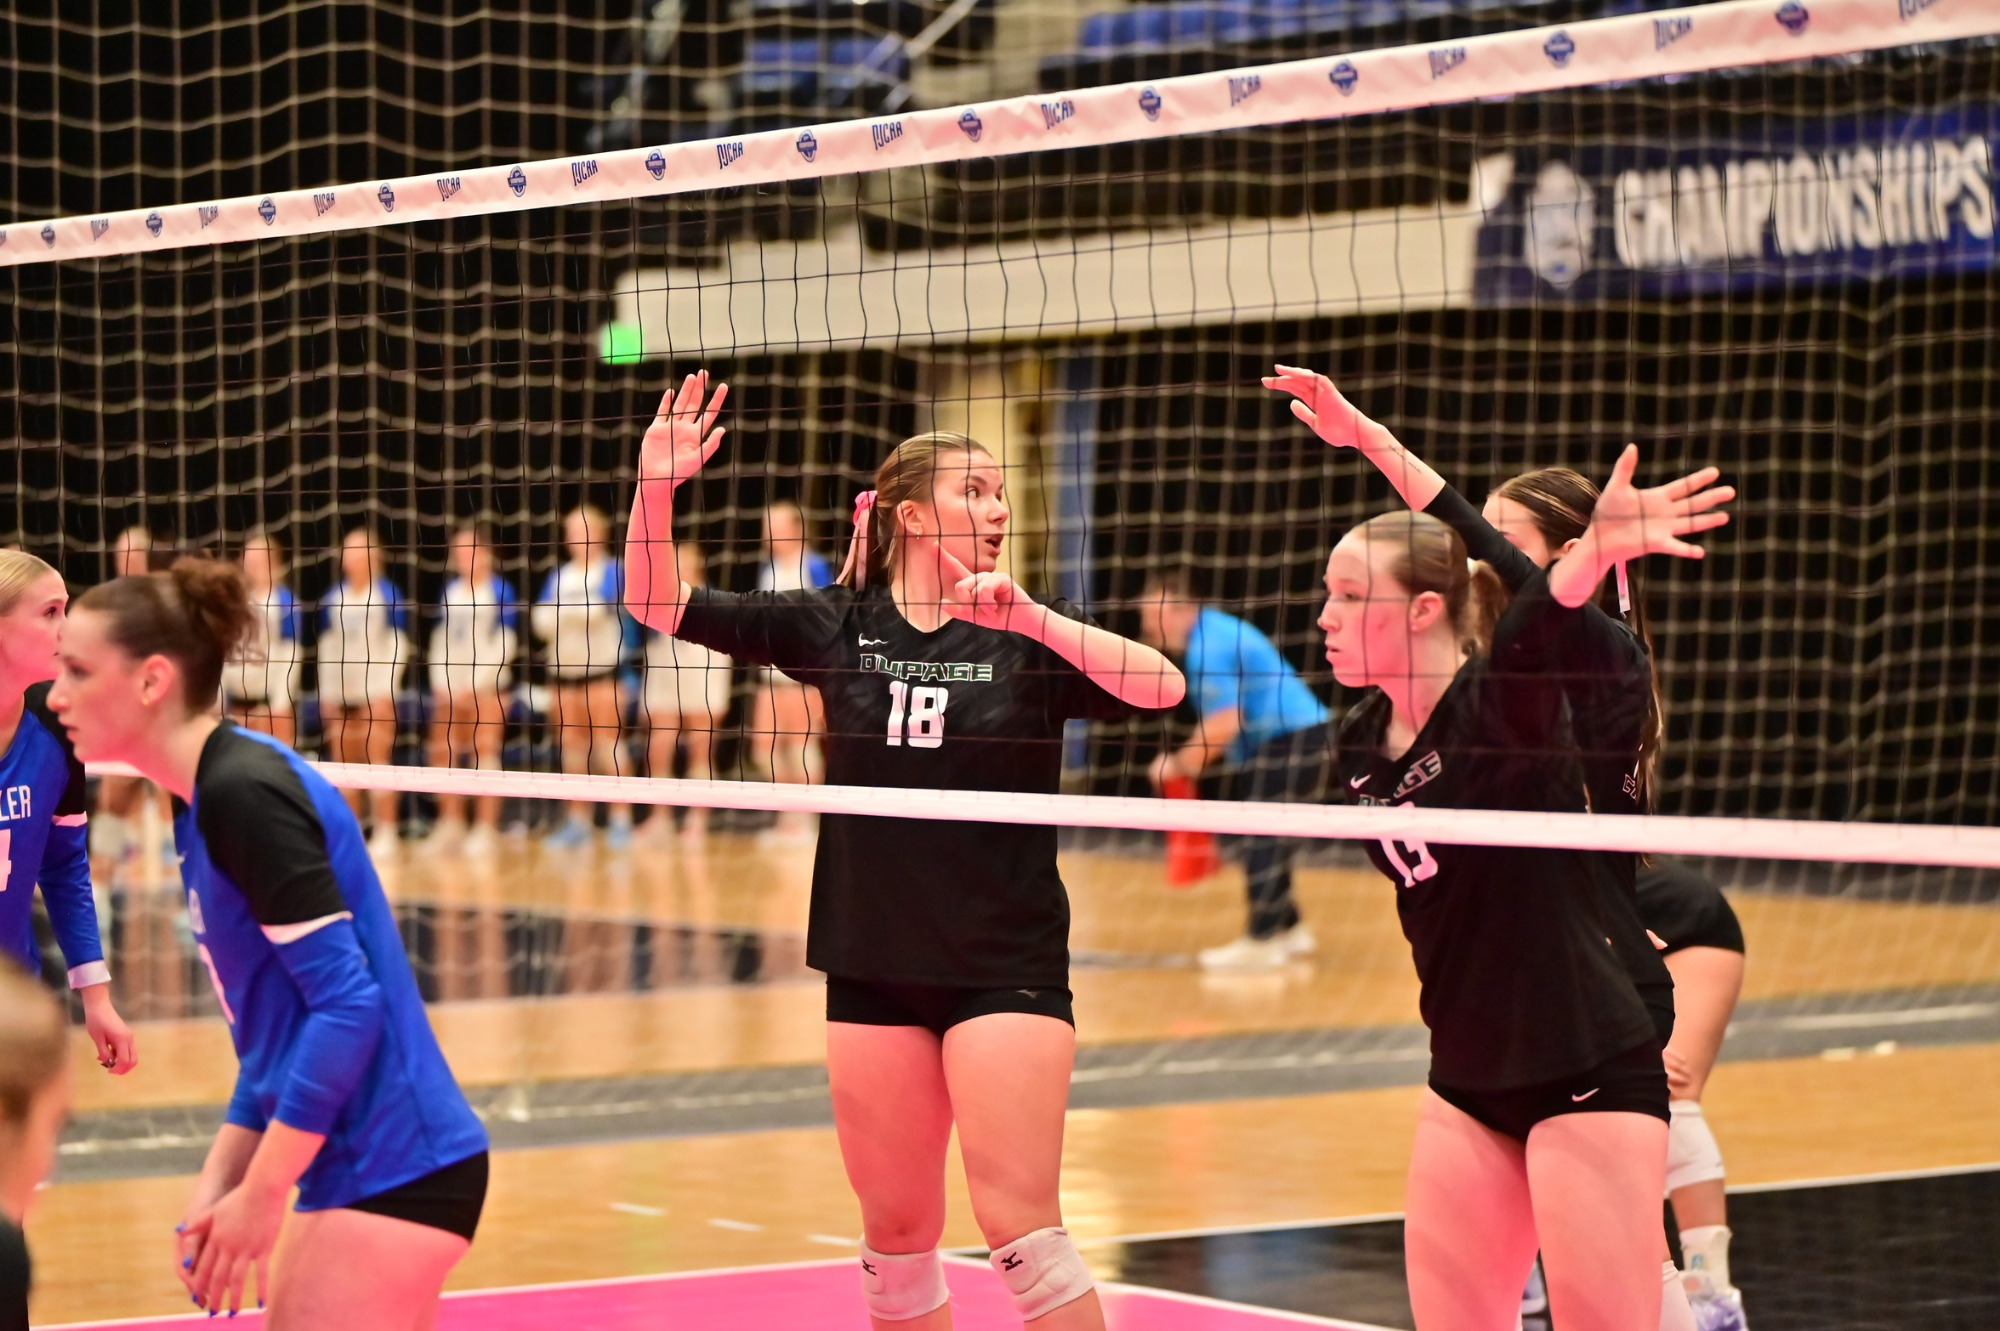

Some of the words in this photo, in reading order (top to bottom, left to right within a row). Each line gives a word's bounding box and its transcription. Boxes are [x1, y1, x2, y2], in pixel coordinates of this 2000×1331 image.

[1653, 17, 1693, 51] NJCAA
[1428, 47, 1467, 79] NJCAA
[1228, 75, 1261, 107] NJCAA
[1041, 100, 1076, 130] NJCAA
[872, 121, 903, 150] NJCAA
[716, 141, 744, 170] NJCAA
[571, 159, 598, 187] NJCAA
[436, 176, 461, 202] NJCAA
[1613, 134, 1994, 269] CHAMPIONSHIPS
[198, 205, 219, 229] NJCAA
[313, 192, 335, 217] NJCAA
[860, 653, 993, 682] DUPAGE
[886, 680, 949, 748] 18
[0, 784, 31, 822] LER
